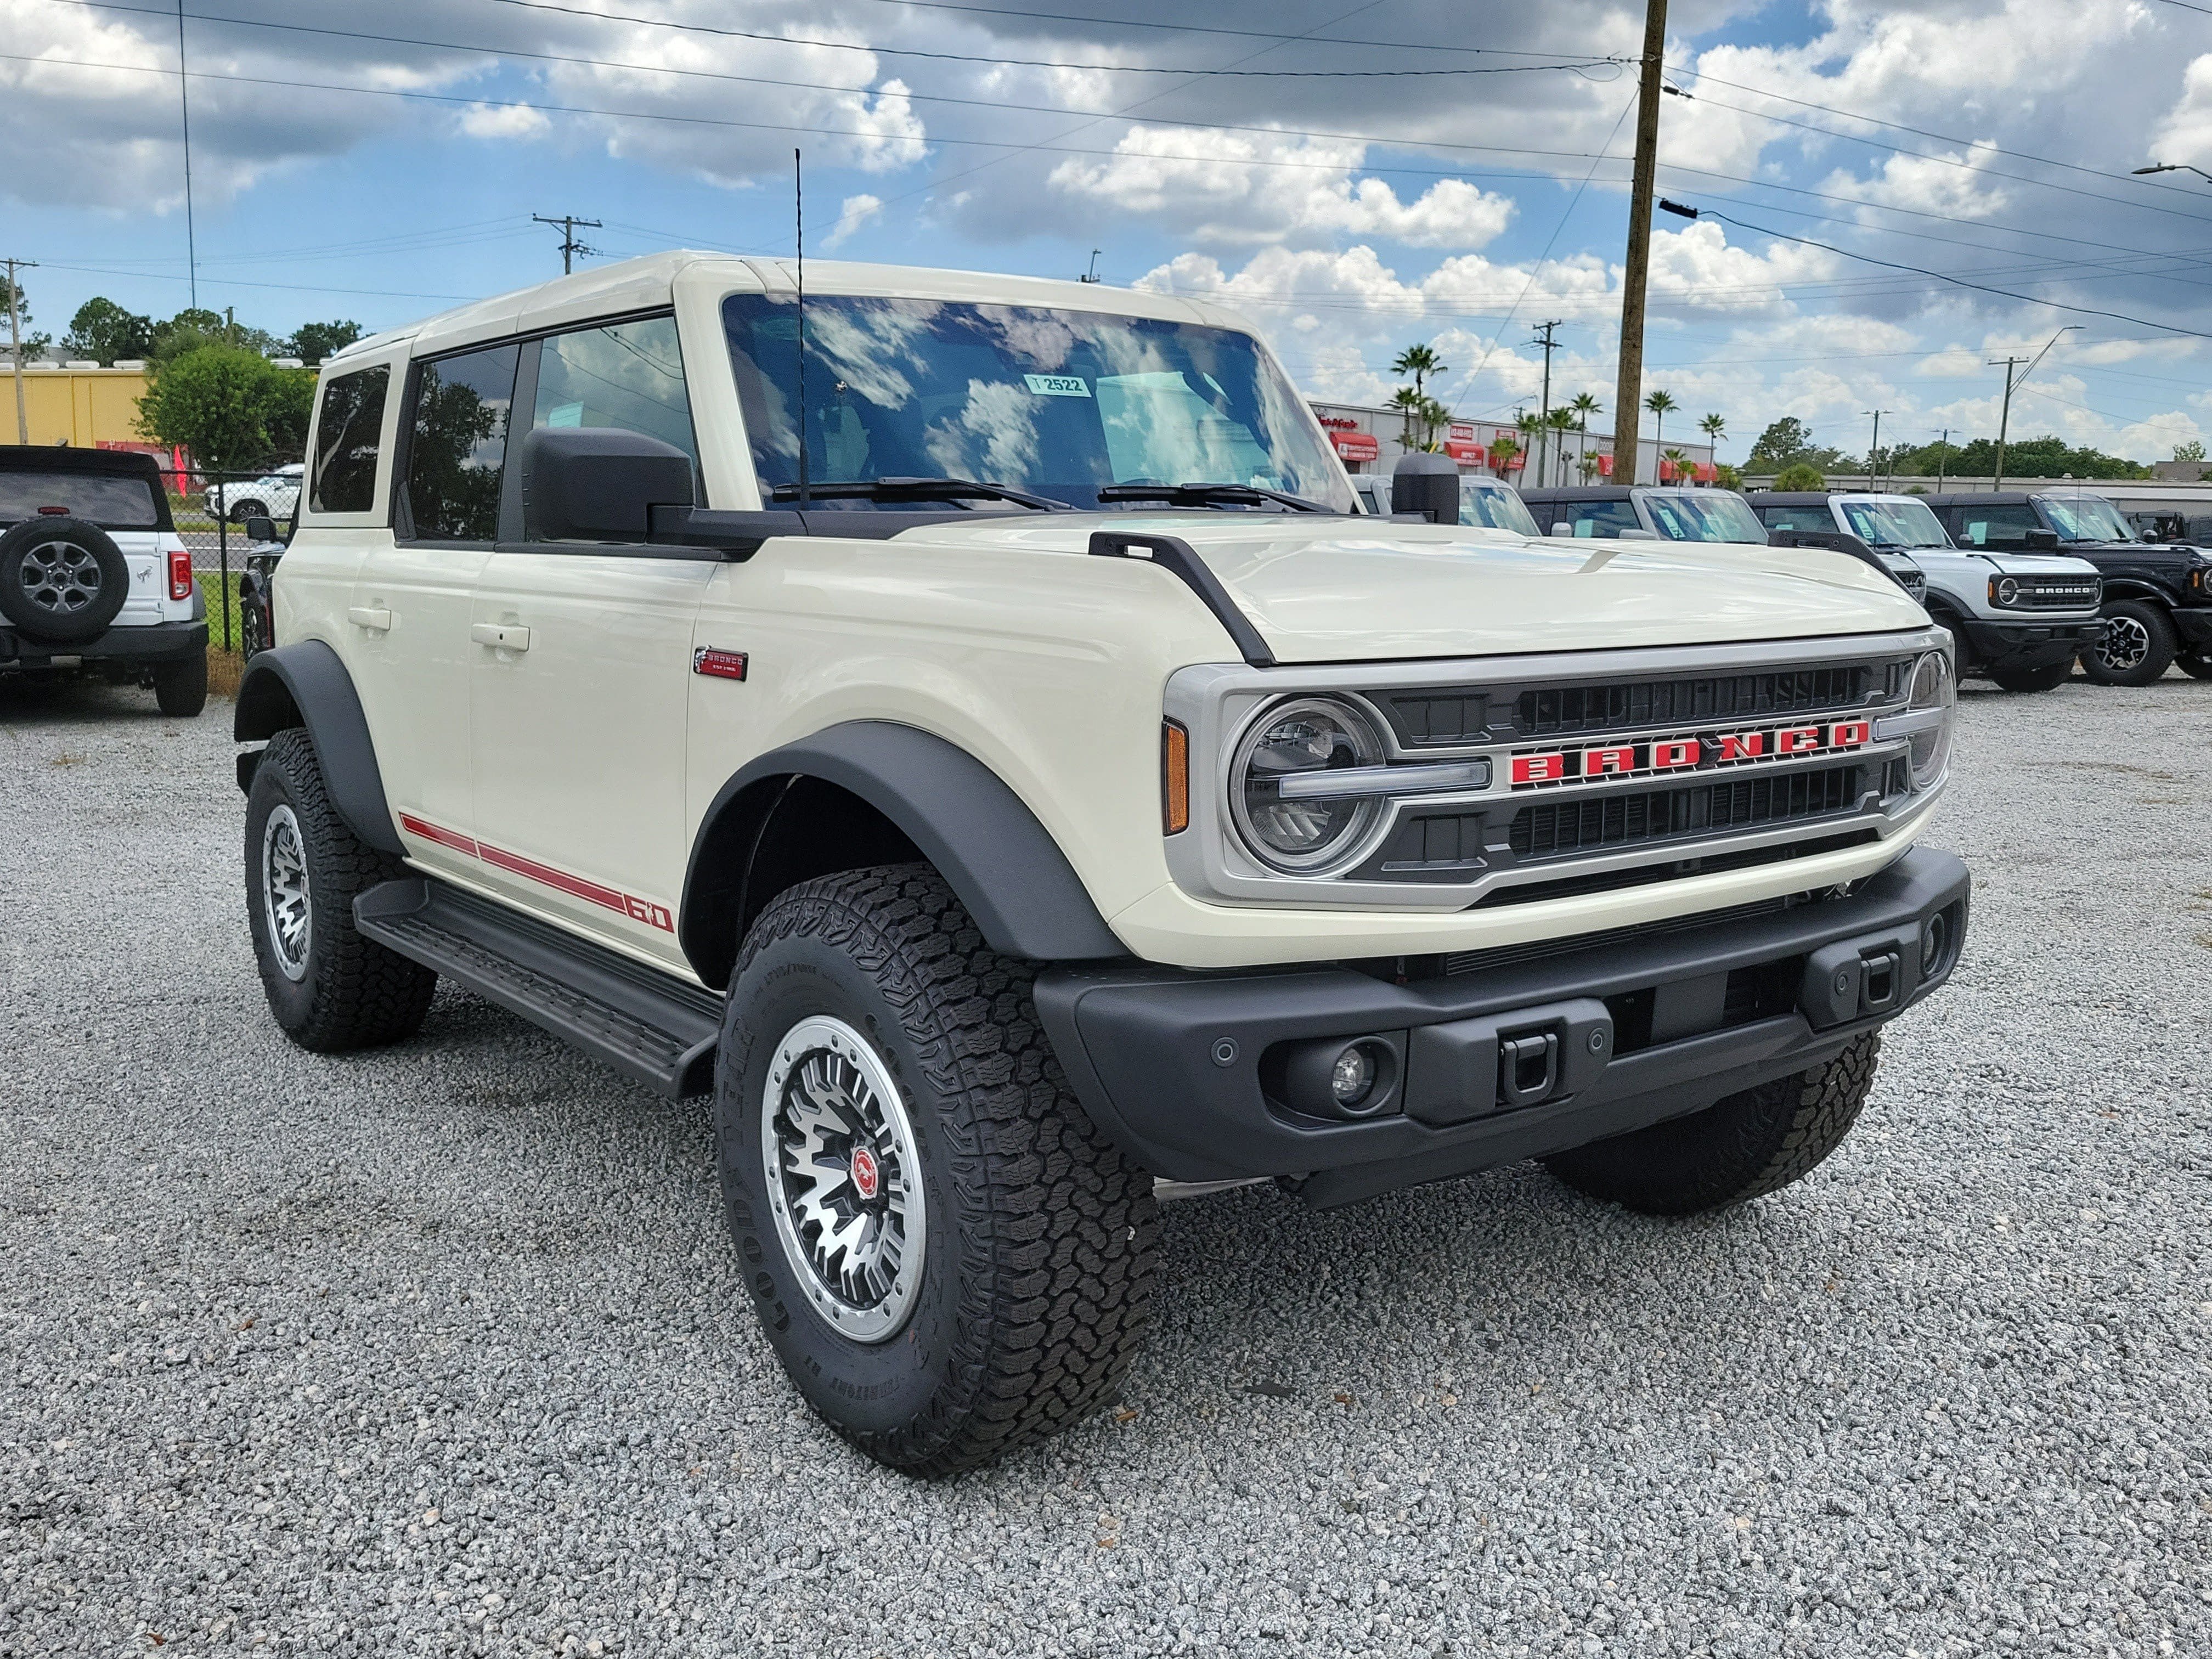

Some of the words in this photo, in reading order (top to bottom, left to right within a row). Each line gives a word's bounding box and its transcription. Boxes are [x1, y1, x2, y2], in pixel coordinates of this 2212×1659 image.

[1032, 378, 1041, 389] T
[1043, 379, 1083, 391] 2522
[708, 655, 743, 665] BRONCO
[1508, 720, 1869, 785] BRONCO
[623, 894, 675, 934] 60
